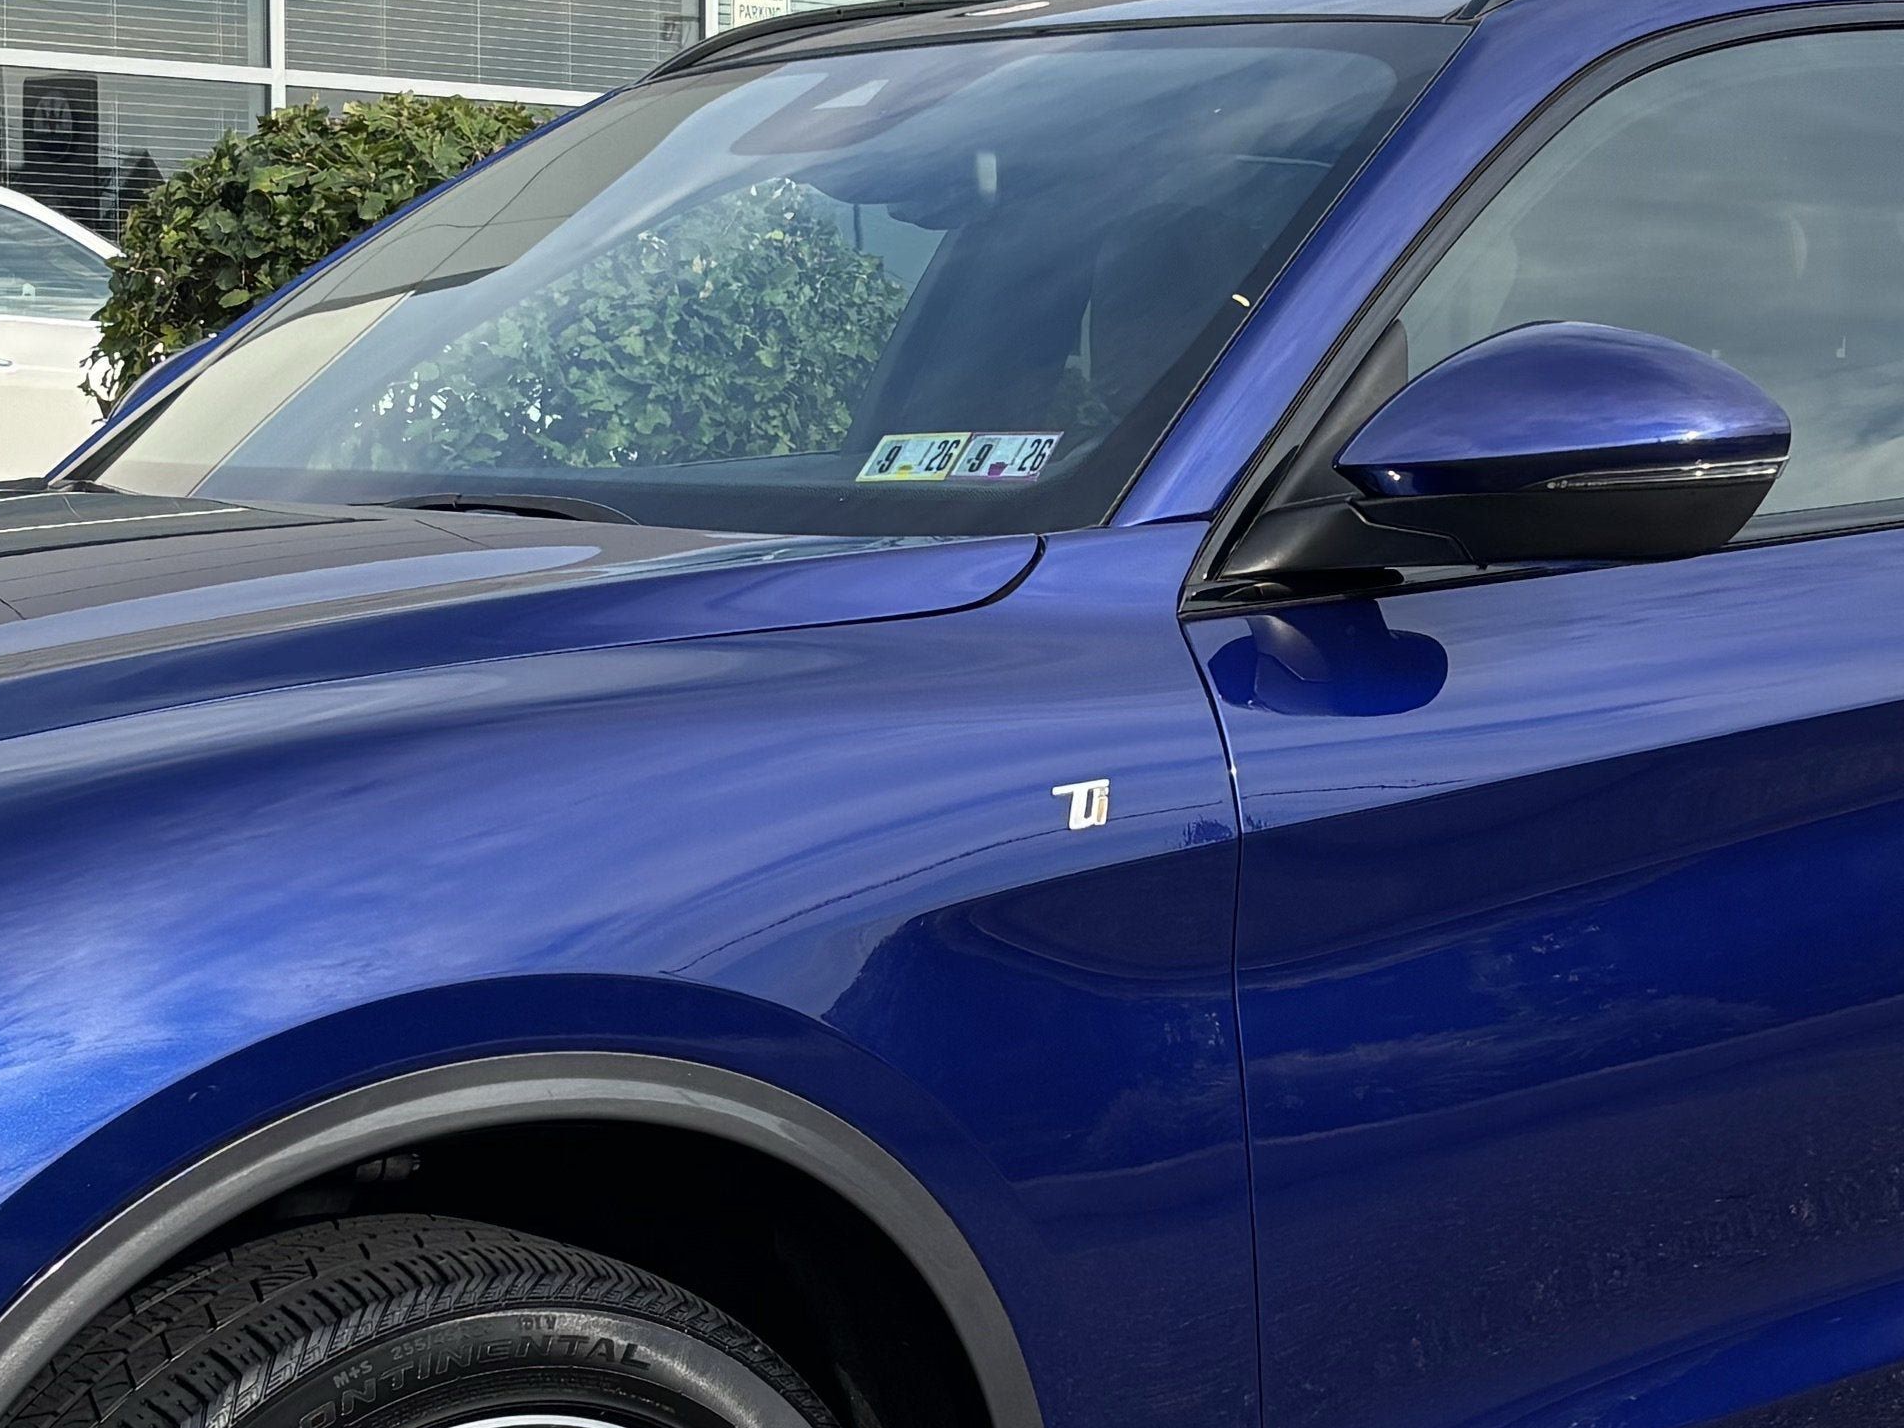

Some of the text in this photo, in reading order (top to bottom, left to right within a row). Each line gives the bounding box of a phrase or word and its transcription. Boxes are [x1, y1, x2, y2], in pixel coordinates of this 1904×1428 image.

[925, 439, 961, 472] 26
[1017, 438, 1054, 472] 26
[1051, 778, 1110, 831] Ti
